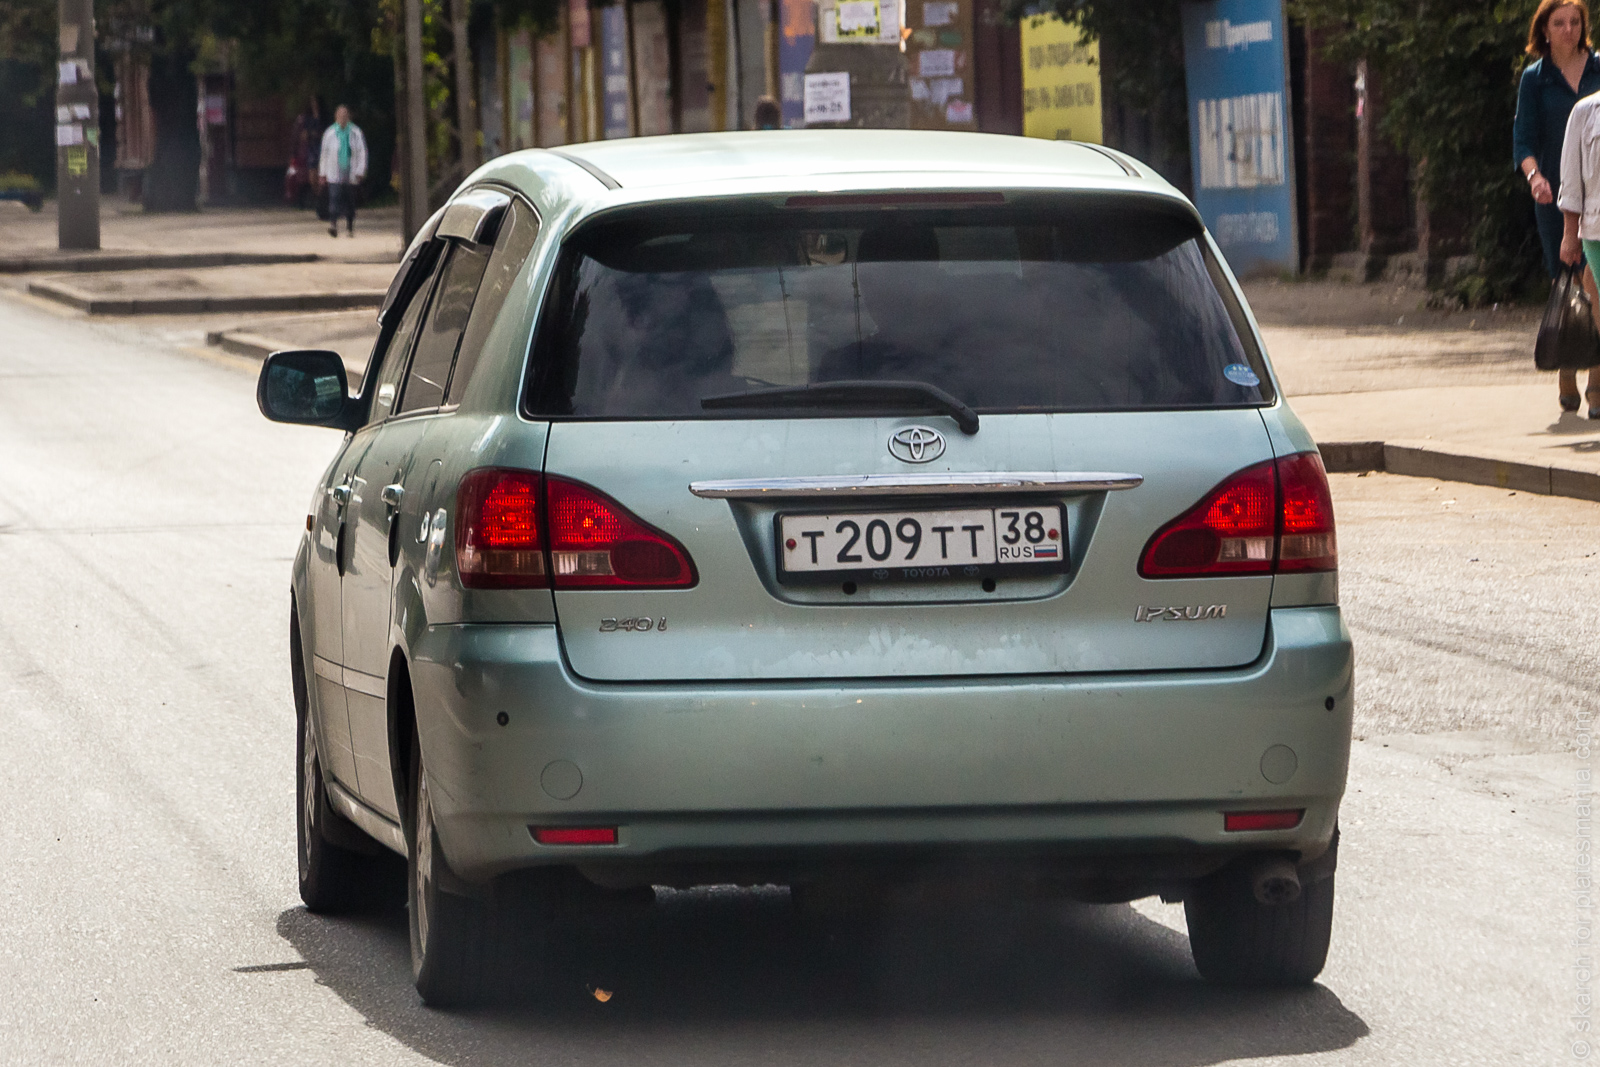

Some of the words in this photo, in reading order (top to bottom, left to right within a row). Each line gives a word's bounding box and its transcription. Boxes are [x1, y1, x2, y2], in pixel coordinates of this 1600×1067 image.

[1000, 511, 1046, 545] 38
[999, 545, 1033, 560] RUS
[902, 566, 951, 579] TOYOTA
[1134, 603, 1228, 622] IPSUM
